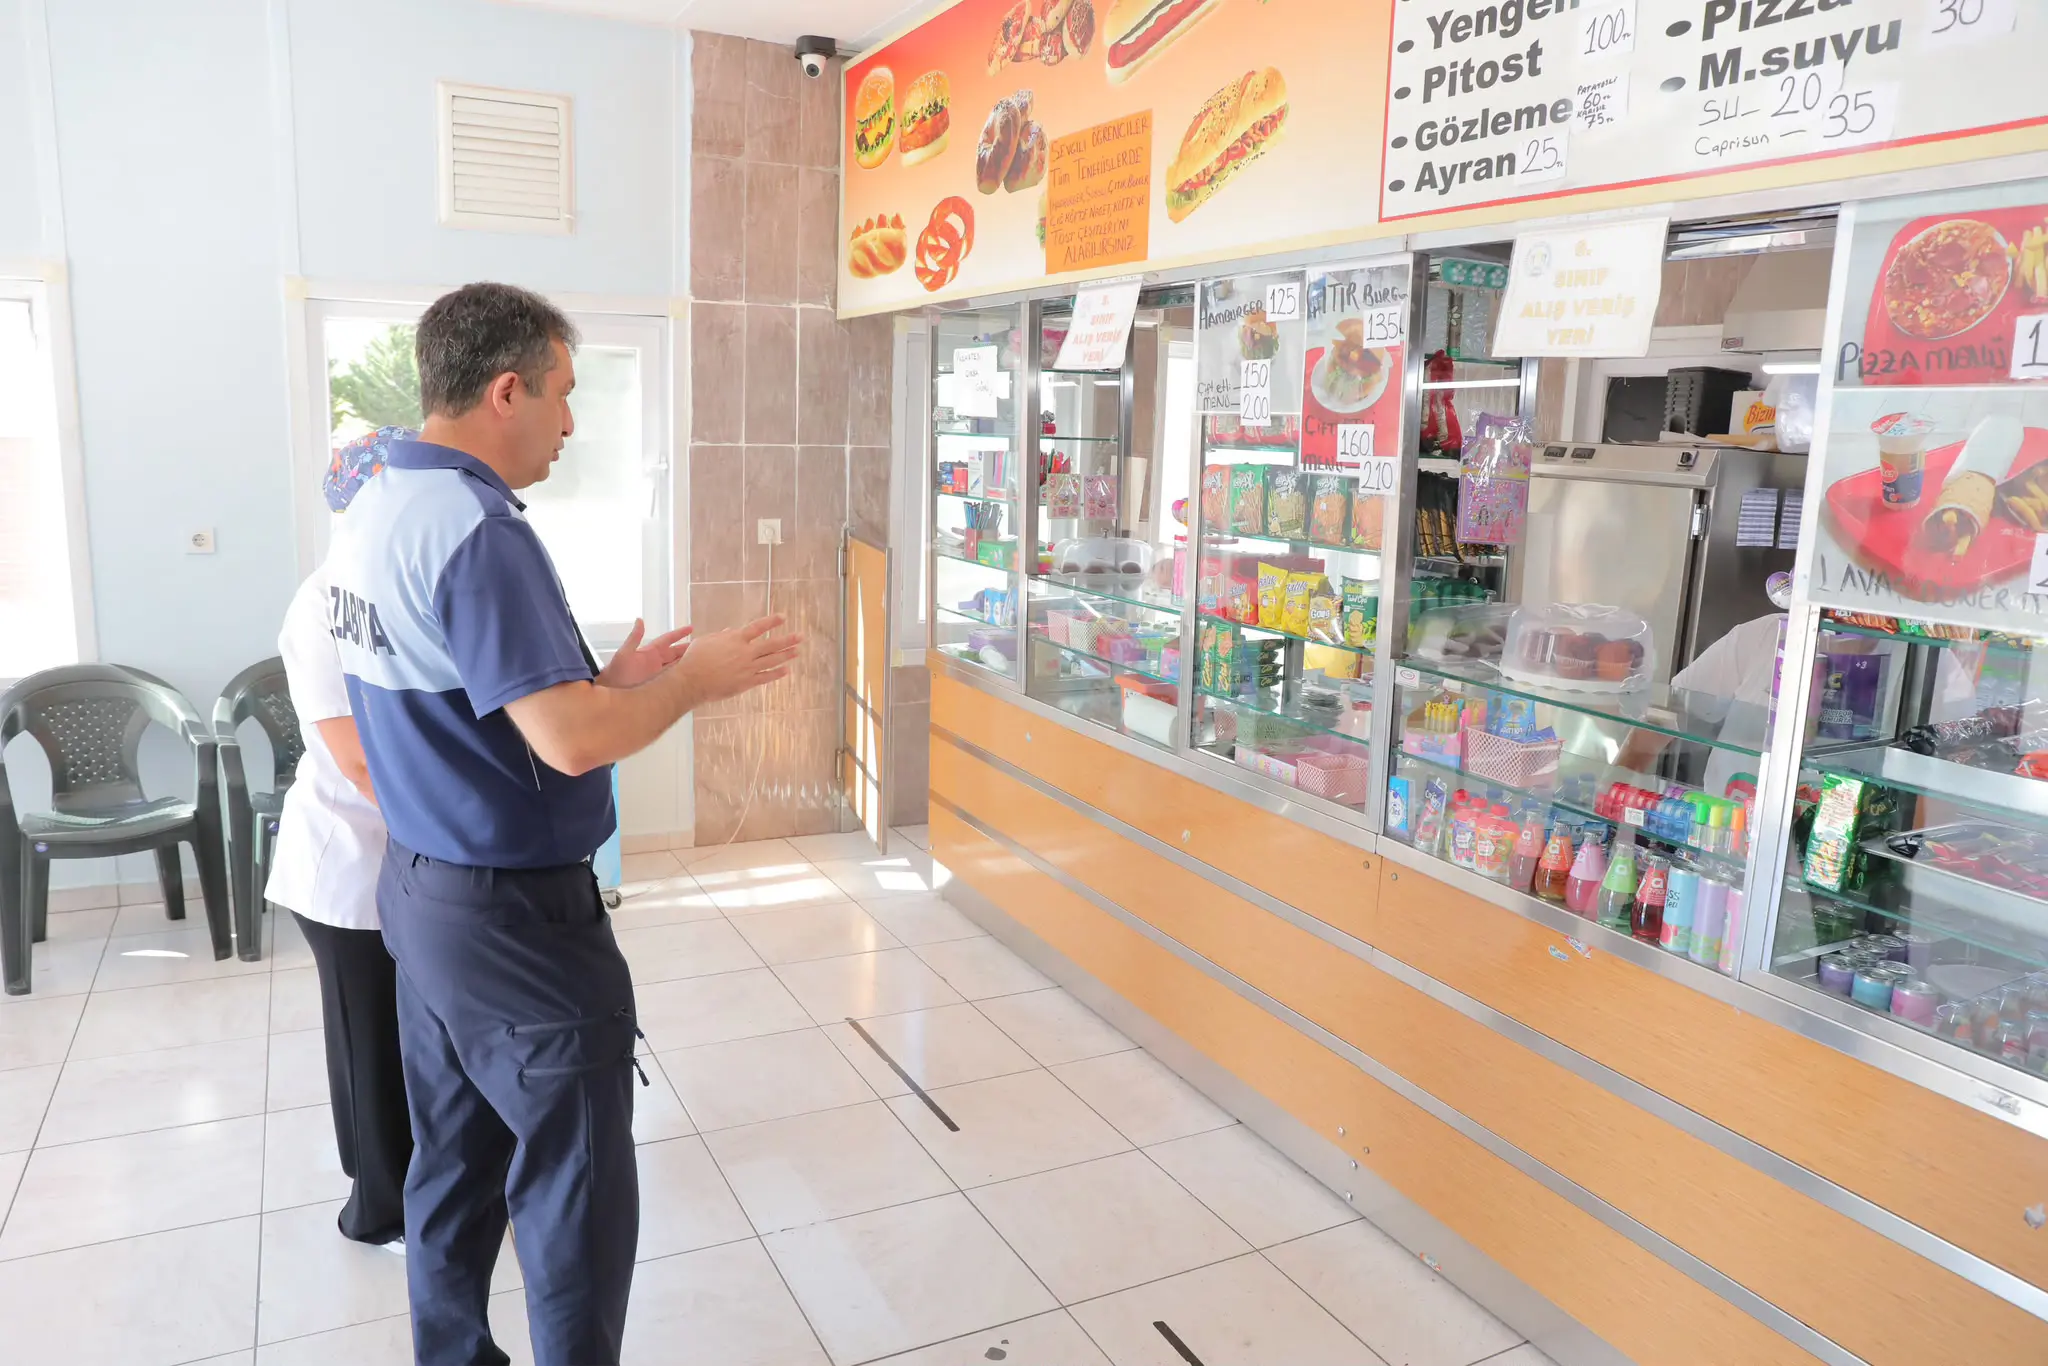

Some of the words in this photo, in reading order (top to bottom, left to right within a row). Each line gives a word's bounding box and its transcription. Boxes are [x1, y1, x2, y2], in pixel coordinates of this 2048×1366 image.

[1584, 8, 1625, 55] 100
[1699, 18, 1902, 91] M.suyu
[1422, 38, 1543, 104] Pitost
[1583, 92, 1601, 110] 60
[1771, 72, 1822, 118] 20
[1415, 97, 1574, 152] Gözleme
[1584, 112, 1604, 129] 75
[1694, 132, 1770, 157] Caprisun
[1823, 90, 1876, 139] 35
[1520, 136, 1558, 175] 25
[1414, 151, 1516, 196] Ayran
[1555, 268, 1609, 288] SINIF
[1200, 300, 1265, 330] HAMBURGER
[1270, 287, 1297, 315] 125
[1366, 312, 1399, 341] 135
[1242, 363, 1269, 389] 150
[1242, 393, 1269, 420] 200
[1340, 429, 1370, 457] 160
[1361, 460, 1394, 491] 210
[330, 585, 398, 657] ZABITA
